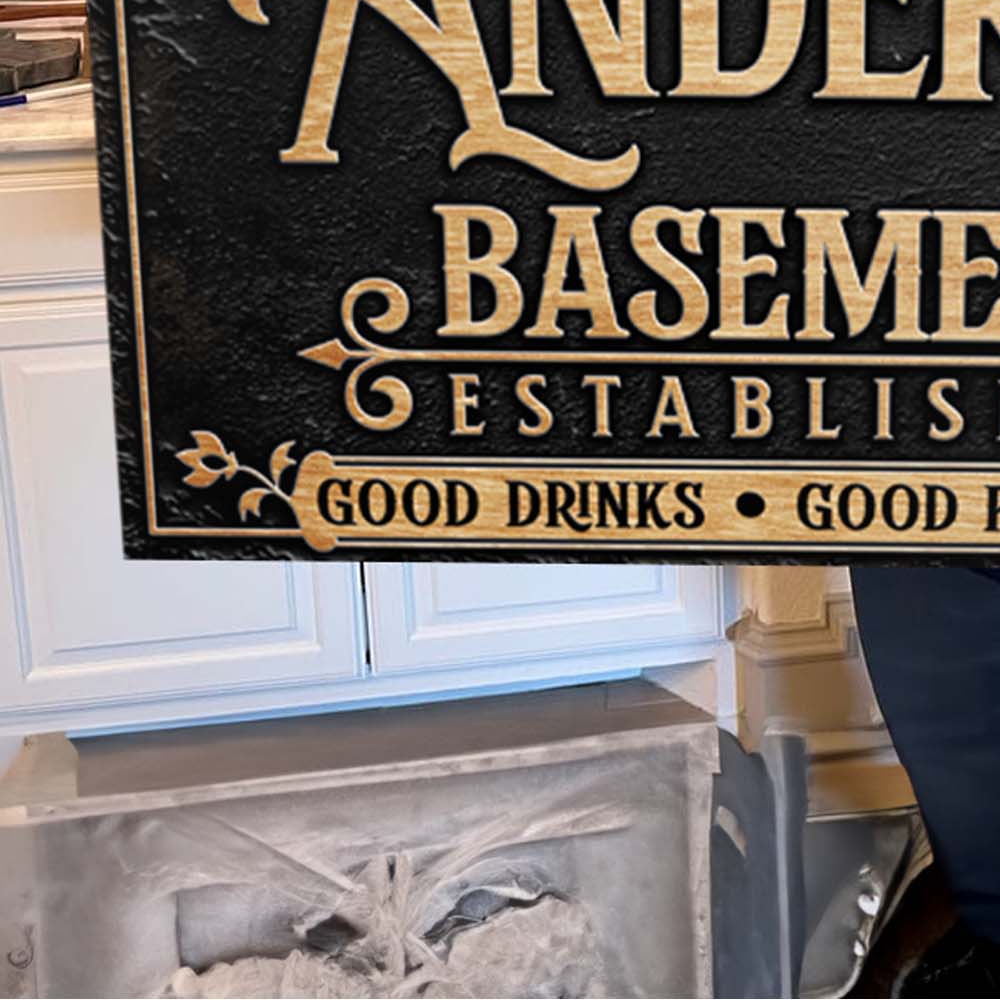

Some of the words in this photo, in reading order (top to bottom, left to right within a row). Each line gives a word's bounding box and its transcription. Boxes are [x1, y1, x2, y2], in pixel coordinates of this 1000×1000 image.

[316, 477, 479, 529] GOOD
[507, 481, 706, 532] DRINKS
[797, 484, 958, 533] GOOD
